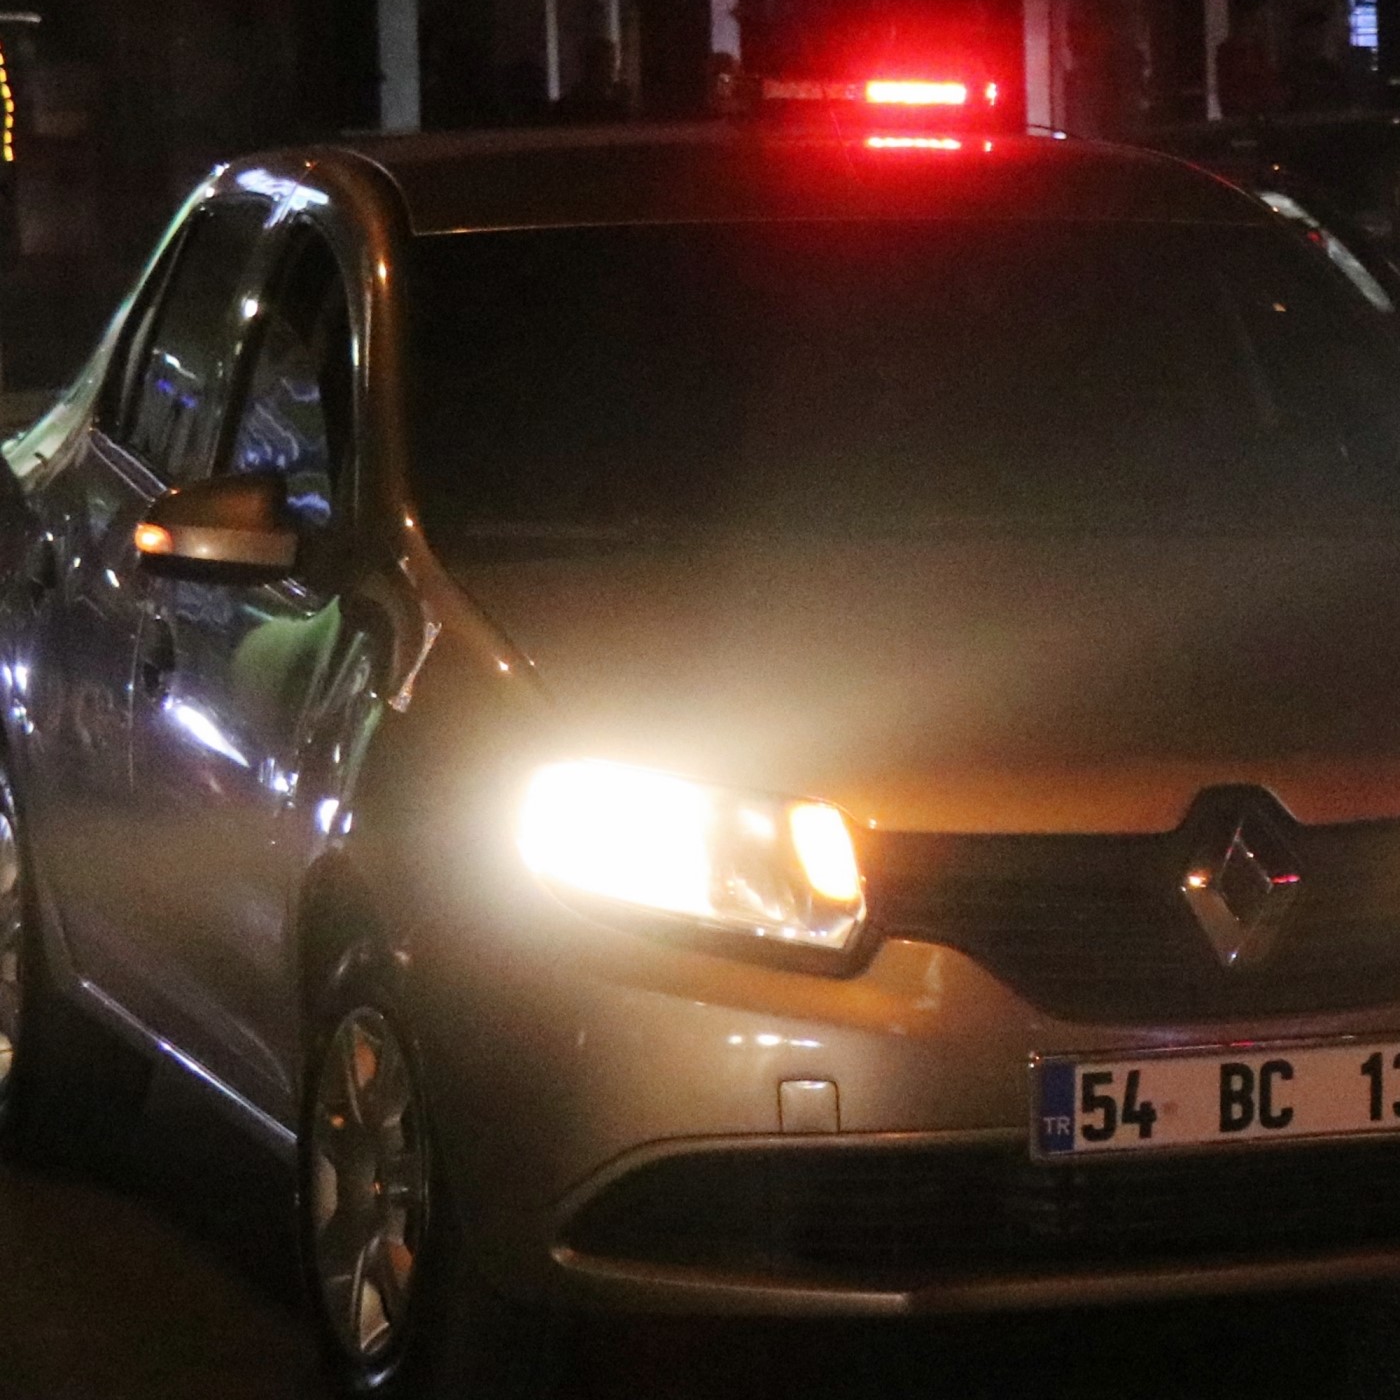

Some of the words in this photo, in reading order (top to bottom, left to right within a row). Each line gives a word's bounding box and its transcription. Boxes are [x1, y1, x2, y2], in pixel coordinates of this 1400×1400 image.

[1043, 1116, 1071, 1134] TR
[1080, 1069, 1157, 1142] 54
[1218, 1059, 1295, 1134] BC
